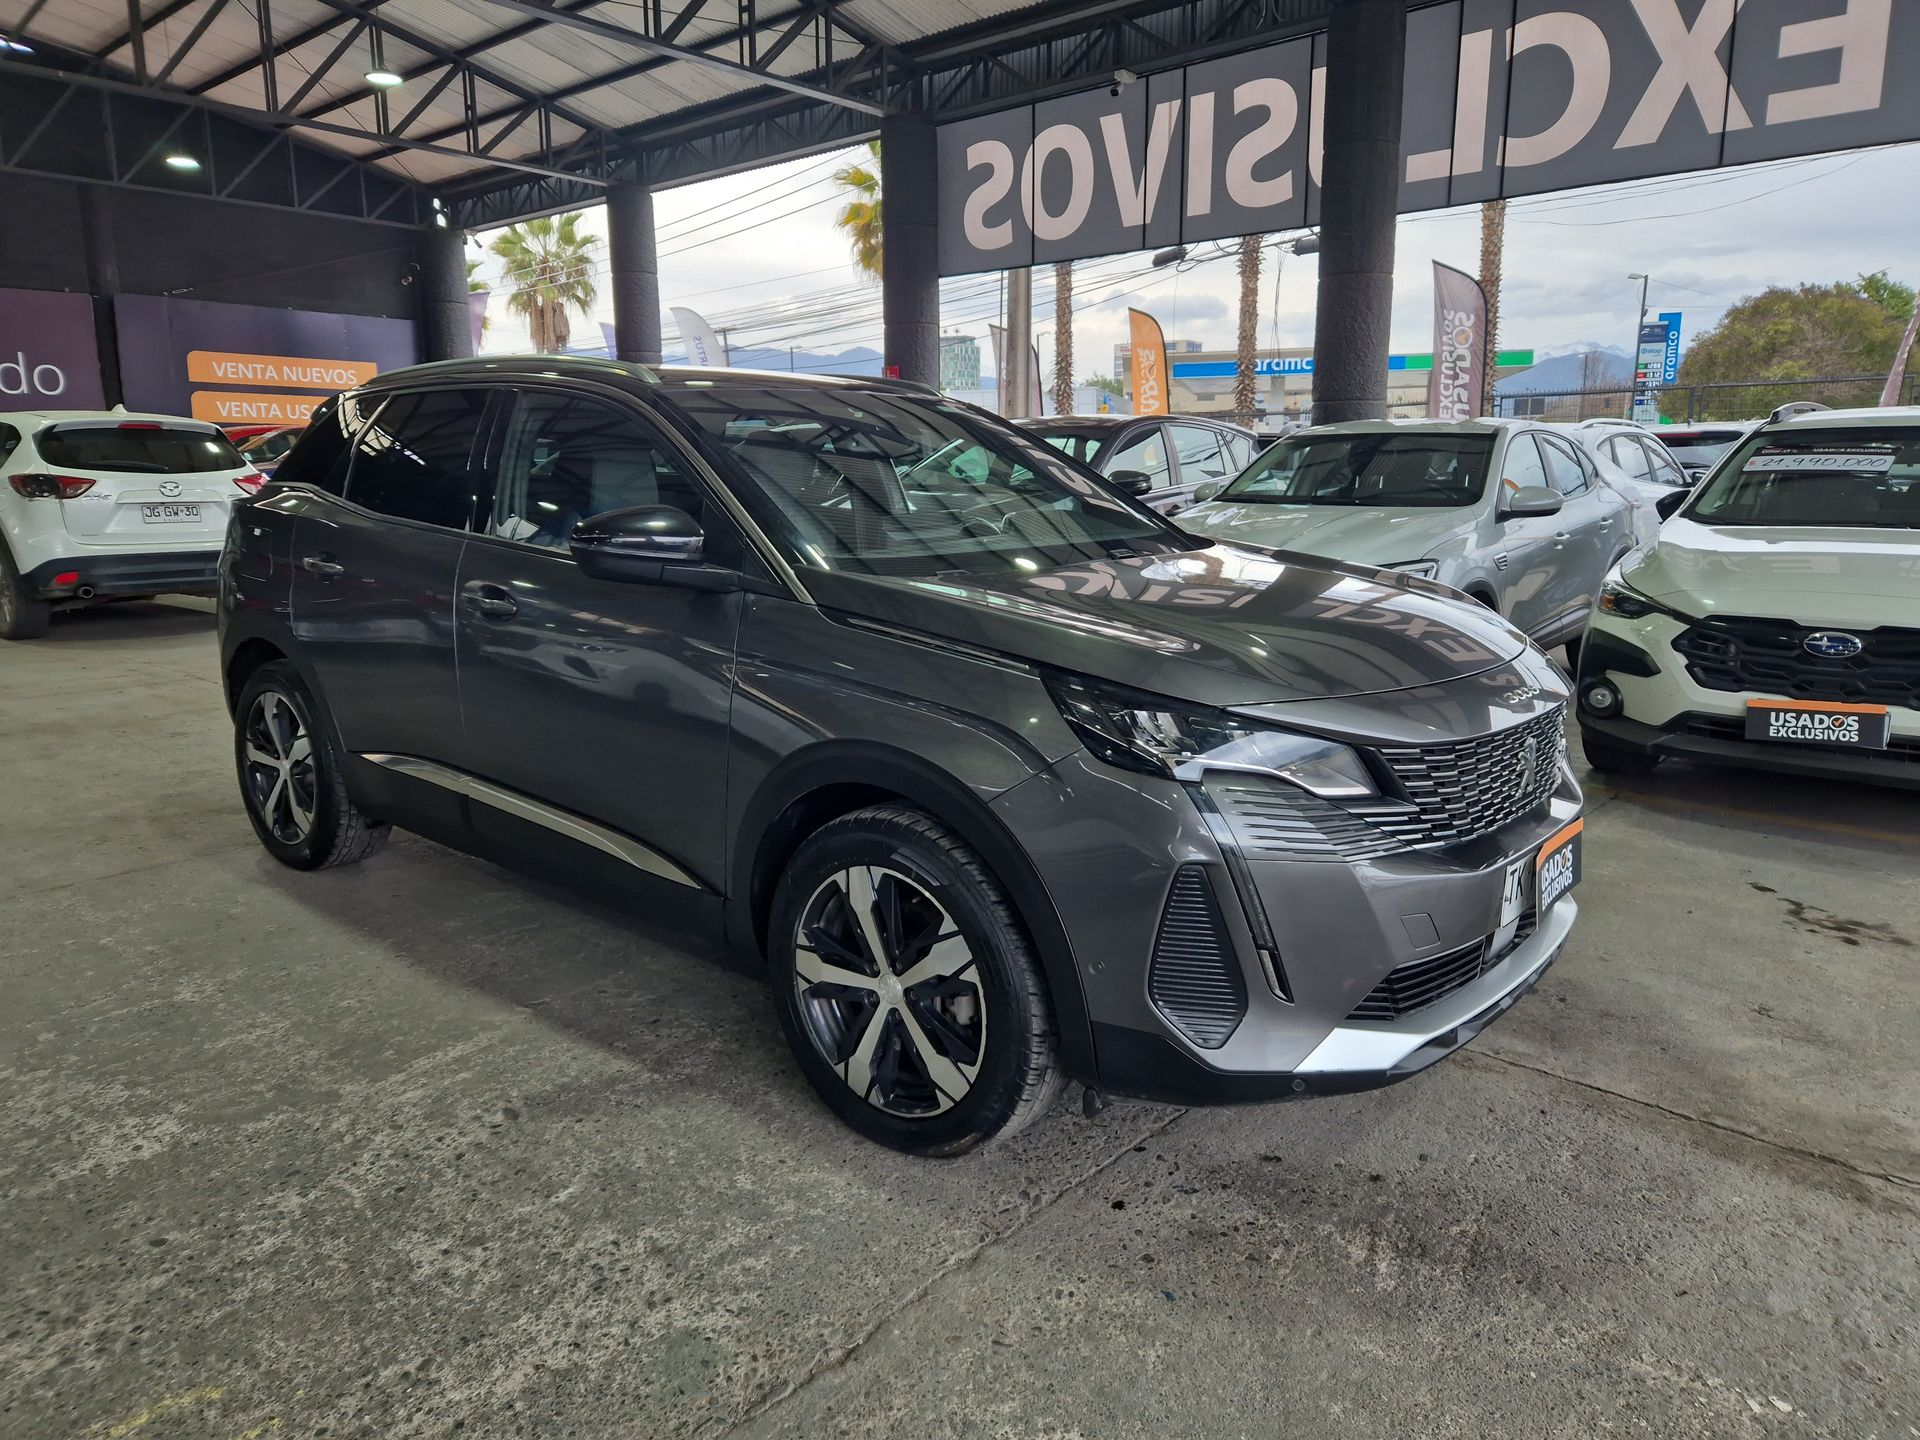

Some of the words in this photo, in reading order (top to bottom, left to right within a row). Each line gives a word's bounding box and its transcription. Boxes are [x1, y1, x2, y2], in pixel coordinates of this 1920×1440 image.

[1665, 330, 1678, 380] aramco
[0, 352, 64, 395] do
[211, 361, 279, 381] VENTA
[283, 366, 358, 385] NUEVOS
[216, 401, 283, 418] VENTA
[1769, 725, 1859, 742] EXCLUSIVOS
[1770, 711, 1860, 731] USADOS
[1541, 843, 1573, 892] USADOS
[1541, 866, 1573, 912] EXCLUSIVOS
